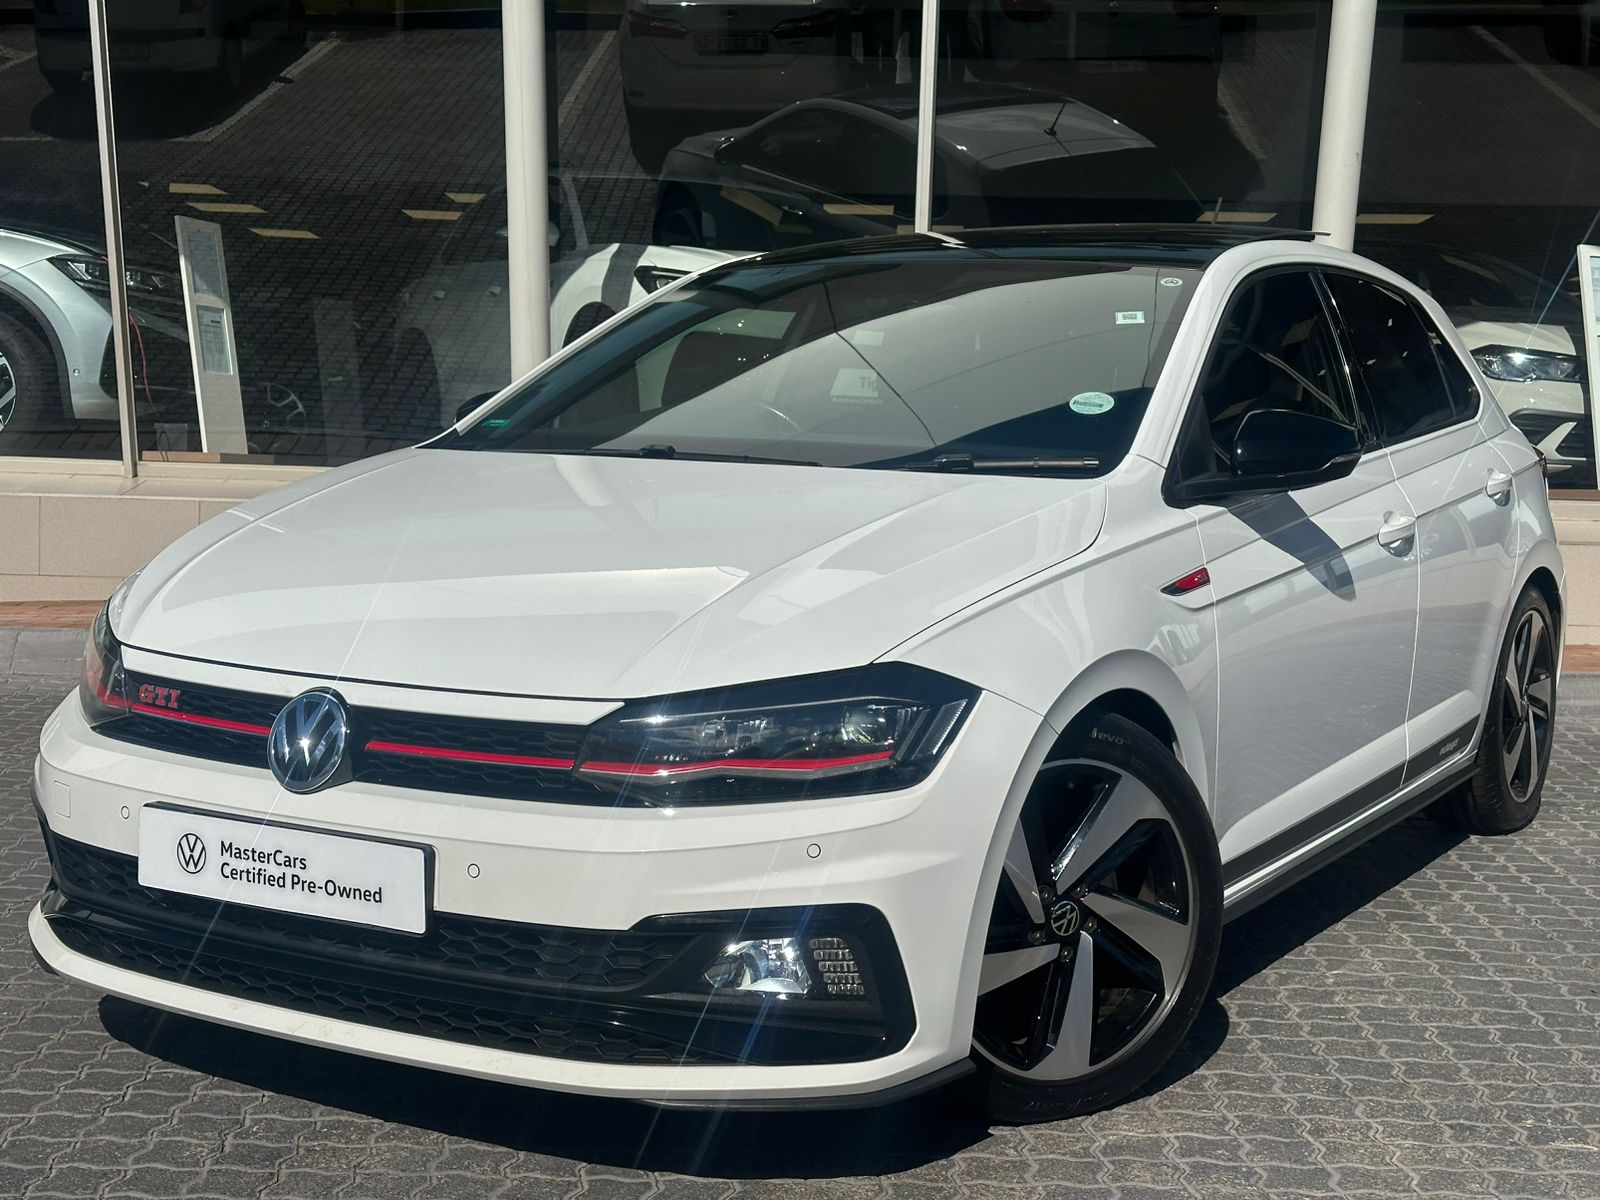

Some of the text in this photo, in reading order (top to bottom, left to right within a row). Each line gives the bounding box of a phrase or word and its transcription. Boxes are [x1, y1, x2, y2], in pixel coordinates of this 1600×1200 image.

[139, 683, 181, 709] GTI
[220, 840, 307, 870] MasterCars
[220, 862, 383, 904] Certified Pre-Owned
